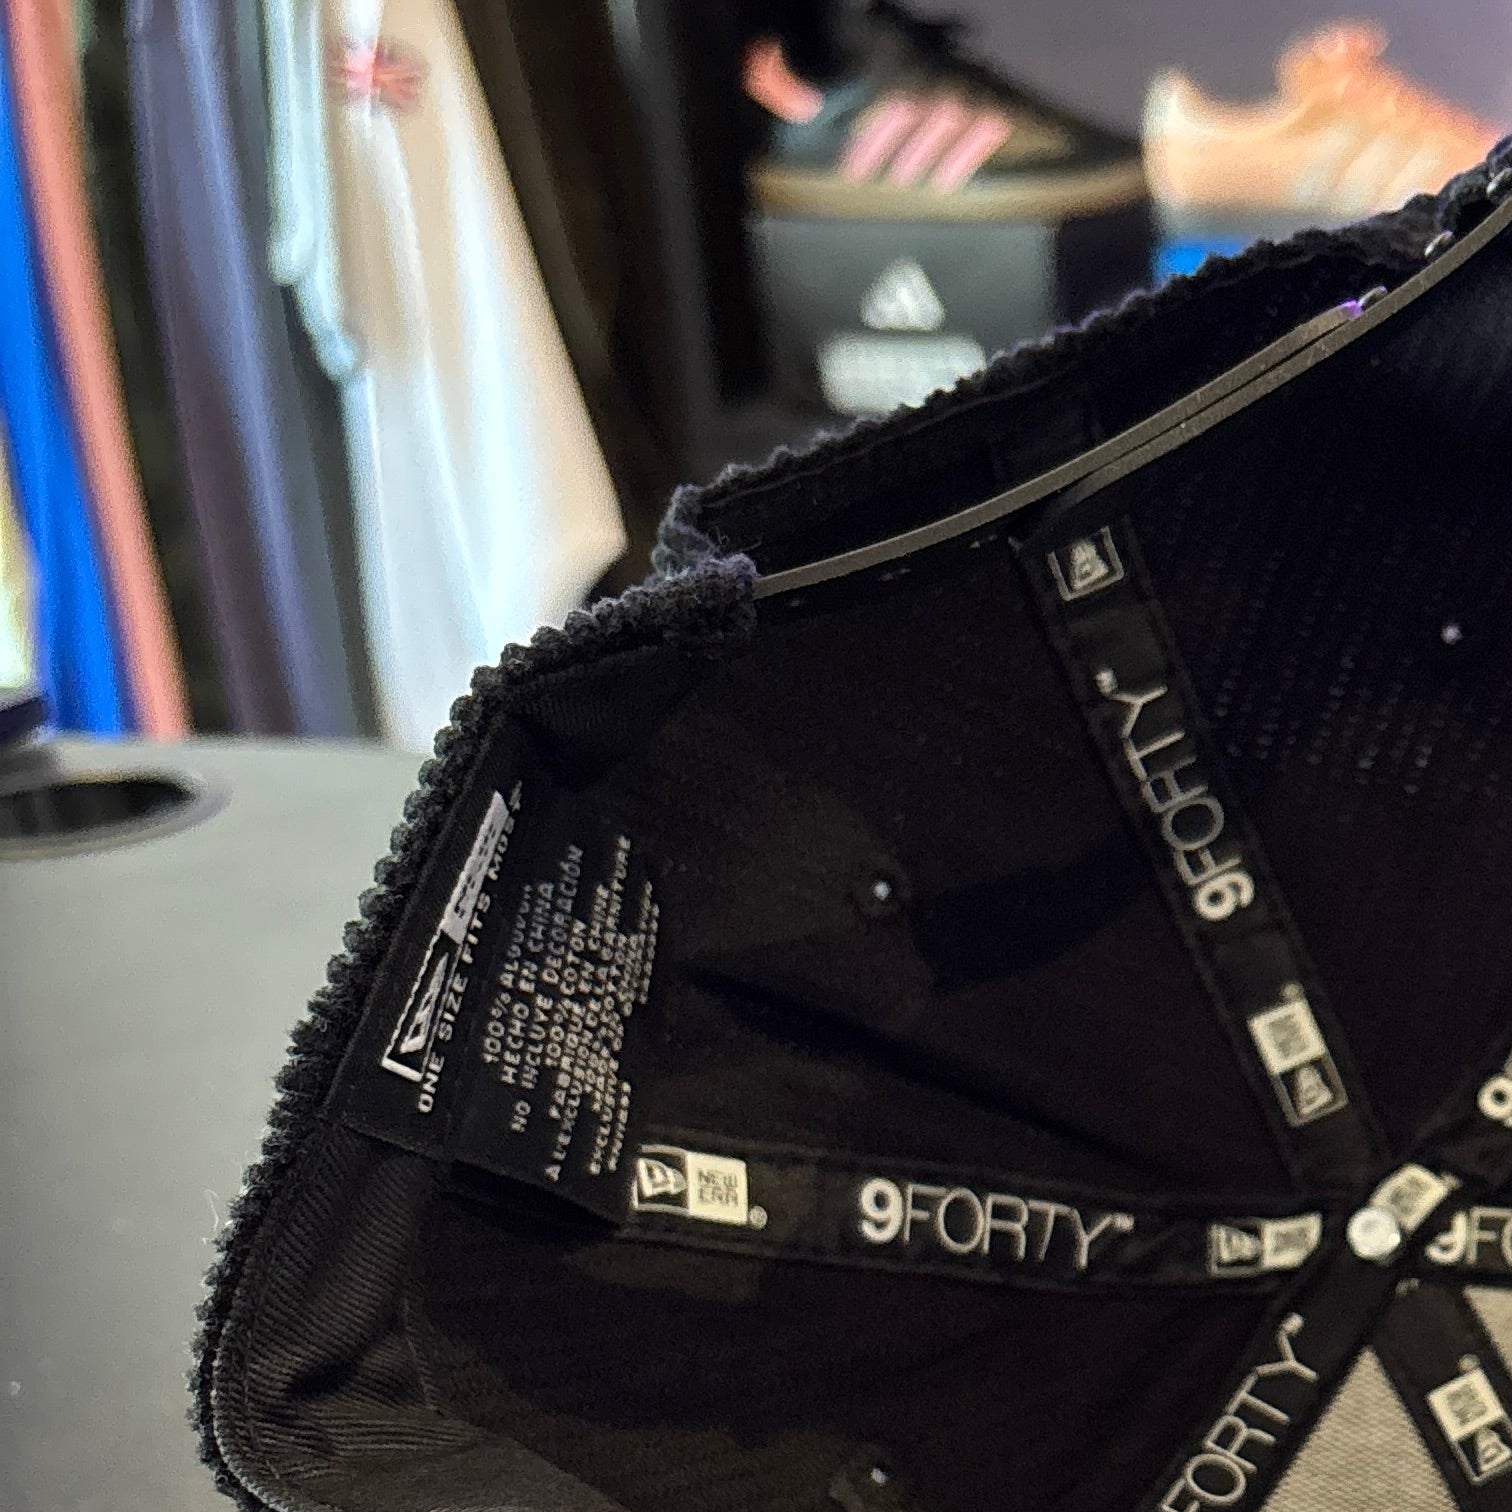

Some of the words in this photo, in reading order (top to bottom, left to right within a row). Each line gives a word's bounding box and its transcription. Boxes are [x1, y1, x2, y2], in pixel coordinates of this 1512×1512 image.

[418, 1051, 445, 1113] ONE
[438, 972, 469, 1042] SIZE
[461, 892, 491, 964] FITS
[501, 1001, 530, 1085] HECHO
